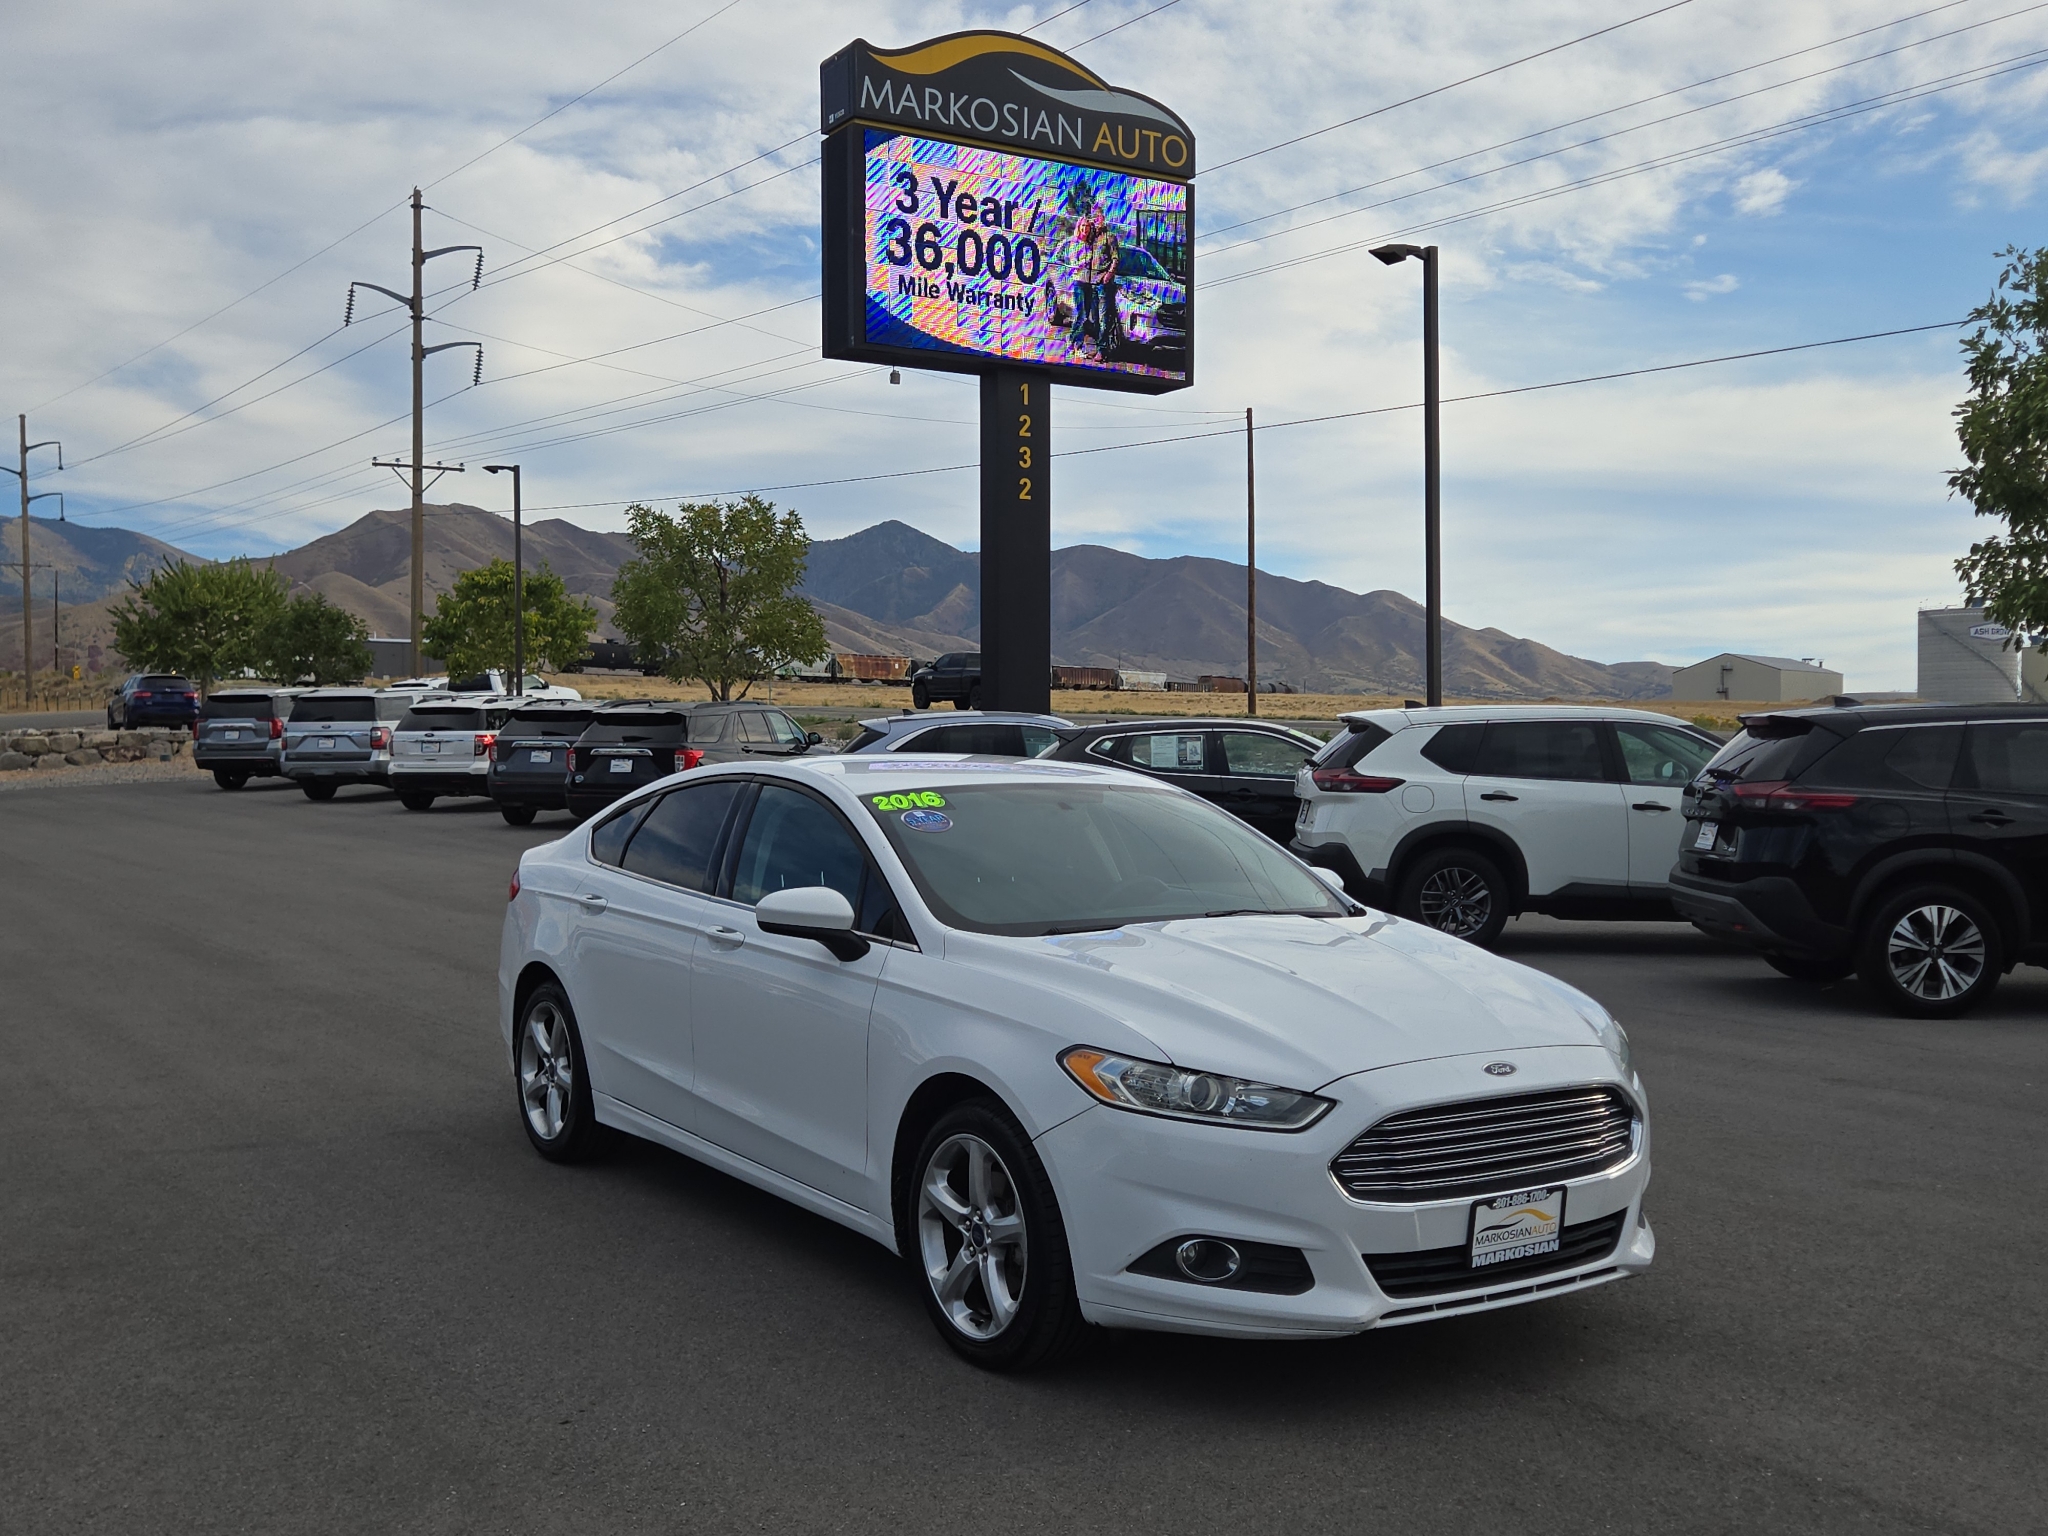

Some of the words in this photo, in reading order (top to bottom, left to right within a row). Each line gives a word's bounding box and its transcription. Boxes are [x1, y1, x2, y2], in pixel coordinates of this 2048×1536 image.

[860, 75, 1082, 150] MARKOSIAN
[1092, 122, 1188, 168] AUTO
[895, 171, 919, 214] 3
[930, 176, 1018, 230] Year
[886, 218, 1041, 285] 36,000
[899, 274, 940, 299] Mile
[946, 281, 1034, 318] Warranty
[1974, 628, 1990, 636] ASH
[1991, 628, 2013, 636] GROV
[872, 791, 946, 811] 2016
[1490, 1064, 1512, 1074] Ford
[1472, 1240, 1560, 1269] MARKOSIAN
